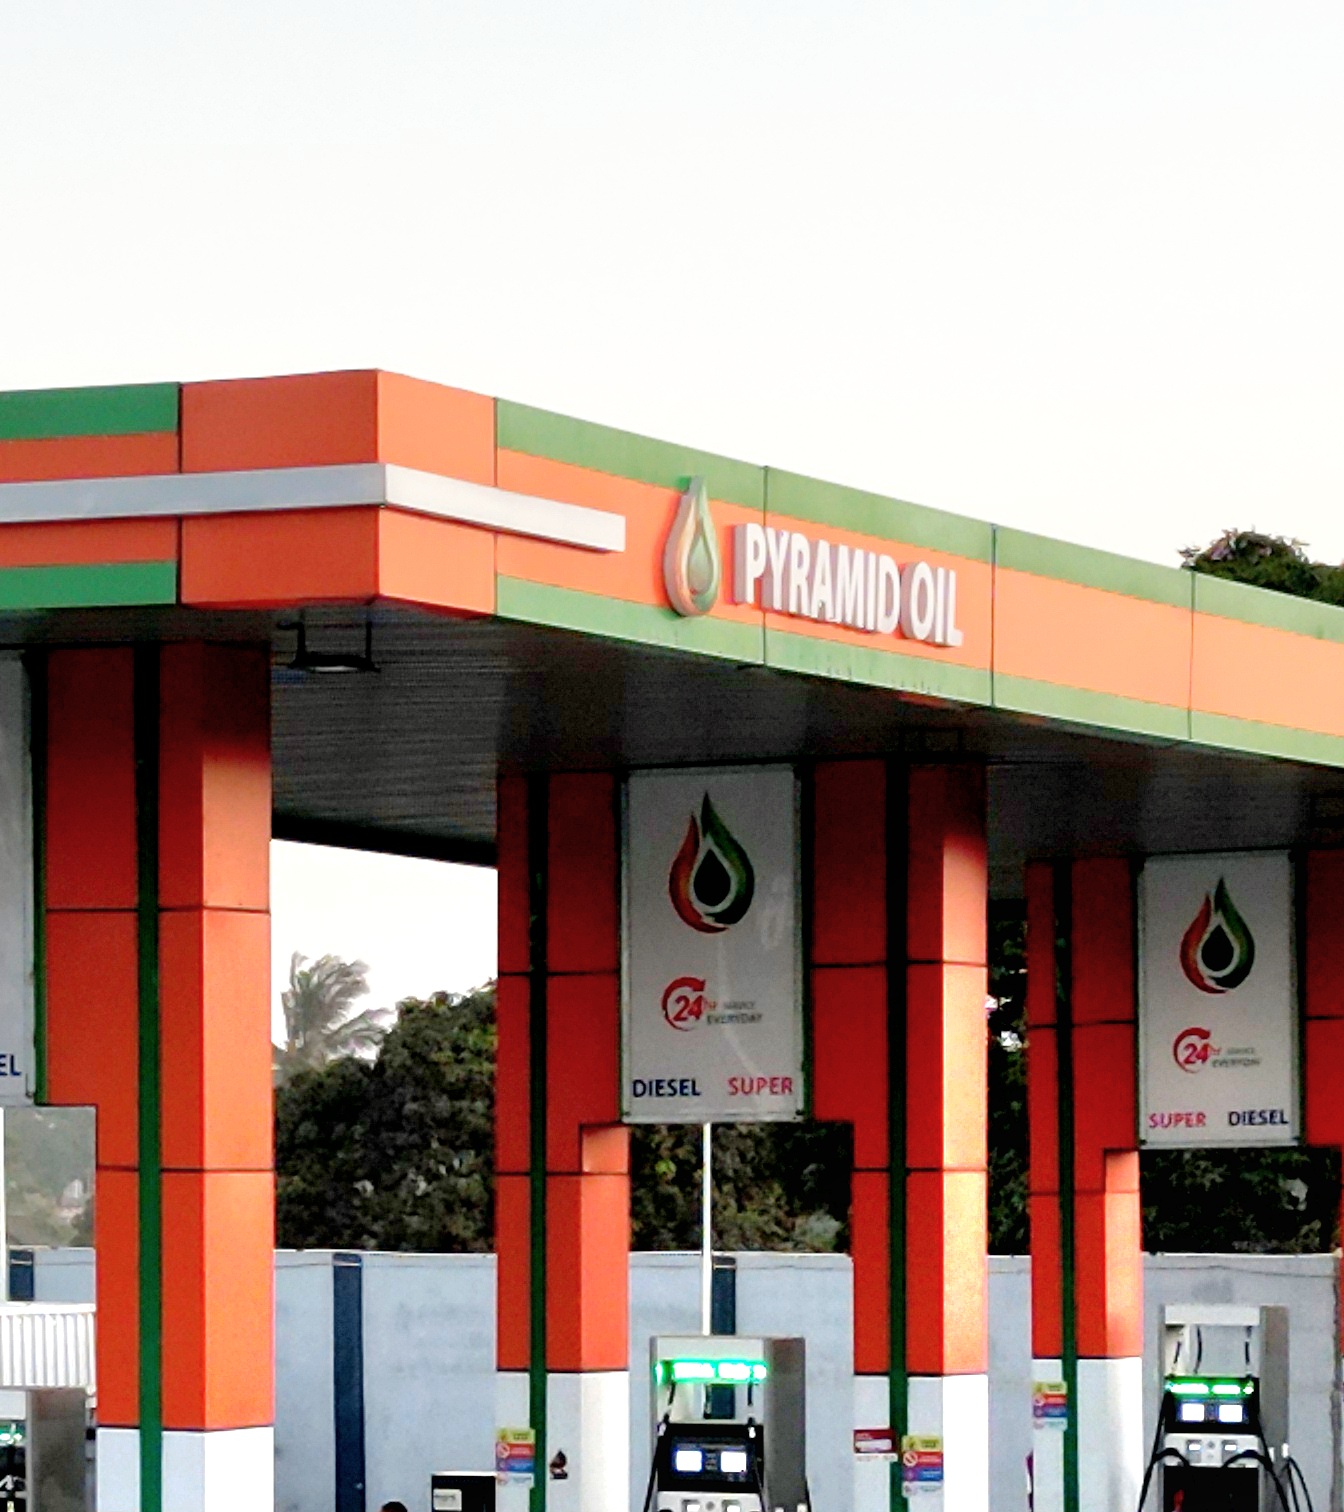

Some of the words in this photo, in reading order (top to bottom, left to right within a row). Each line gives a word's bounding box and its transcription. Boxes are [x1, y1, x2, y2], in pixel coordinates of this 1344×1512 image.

[735, 522, 901, 635] PYRAMID
[903, 560, 964, 647] OIL
[632, 1078, 702, 1098] DIESEL
[727, 1076, 793, 1097] SUPER
[1148, 1111, 1206, 1129] SUPER
[1227, 1108, 1290, 1127] DIESEL
